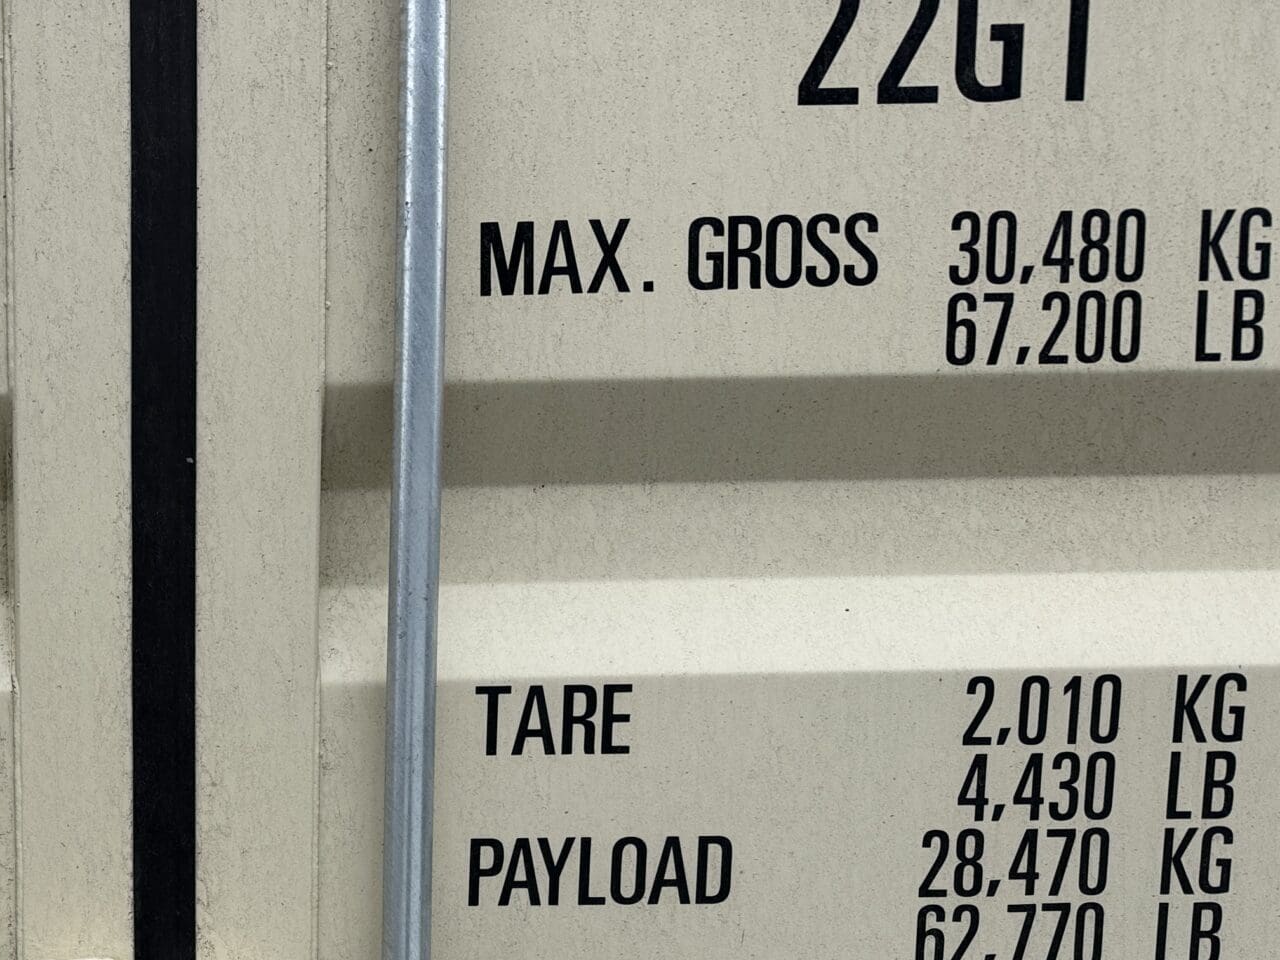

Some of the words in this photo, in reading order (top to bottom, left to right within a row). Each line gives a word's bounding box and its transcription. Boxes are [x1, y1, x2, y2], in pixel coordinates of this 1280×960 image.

[479, 218, 655, 297] MAX.
[687, 211, 879, 291] GROSS
[948, 208, 1147, 286] 30,480
[1198, 207, 1273, 282] KG
[945, 289, 1142, 366] 67,200
[1194, 288, 1265, 362] LB
[475, 683, 633, 756] TARE
[962, 673, 1122, 746] 2,010
[1172, 672, 1248, 744] KG
[957, 751, 1116, 822] 4,430
[1165, 750, 1237, 820] LB
[467, 835, 733, 907] PAYLOAD
[918, 826, 1110, 898] 28,470
[1159, 825, 1234, 896] KG
